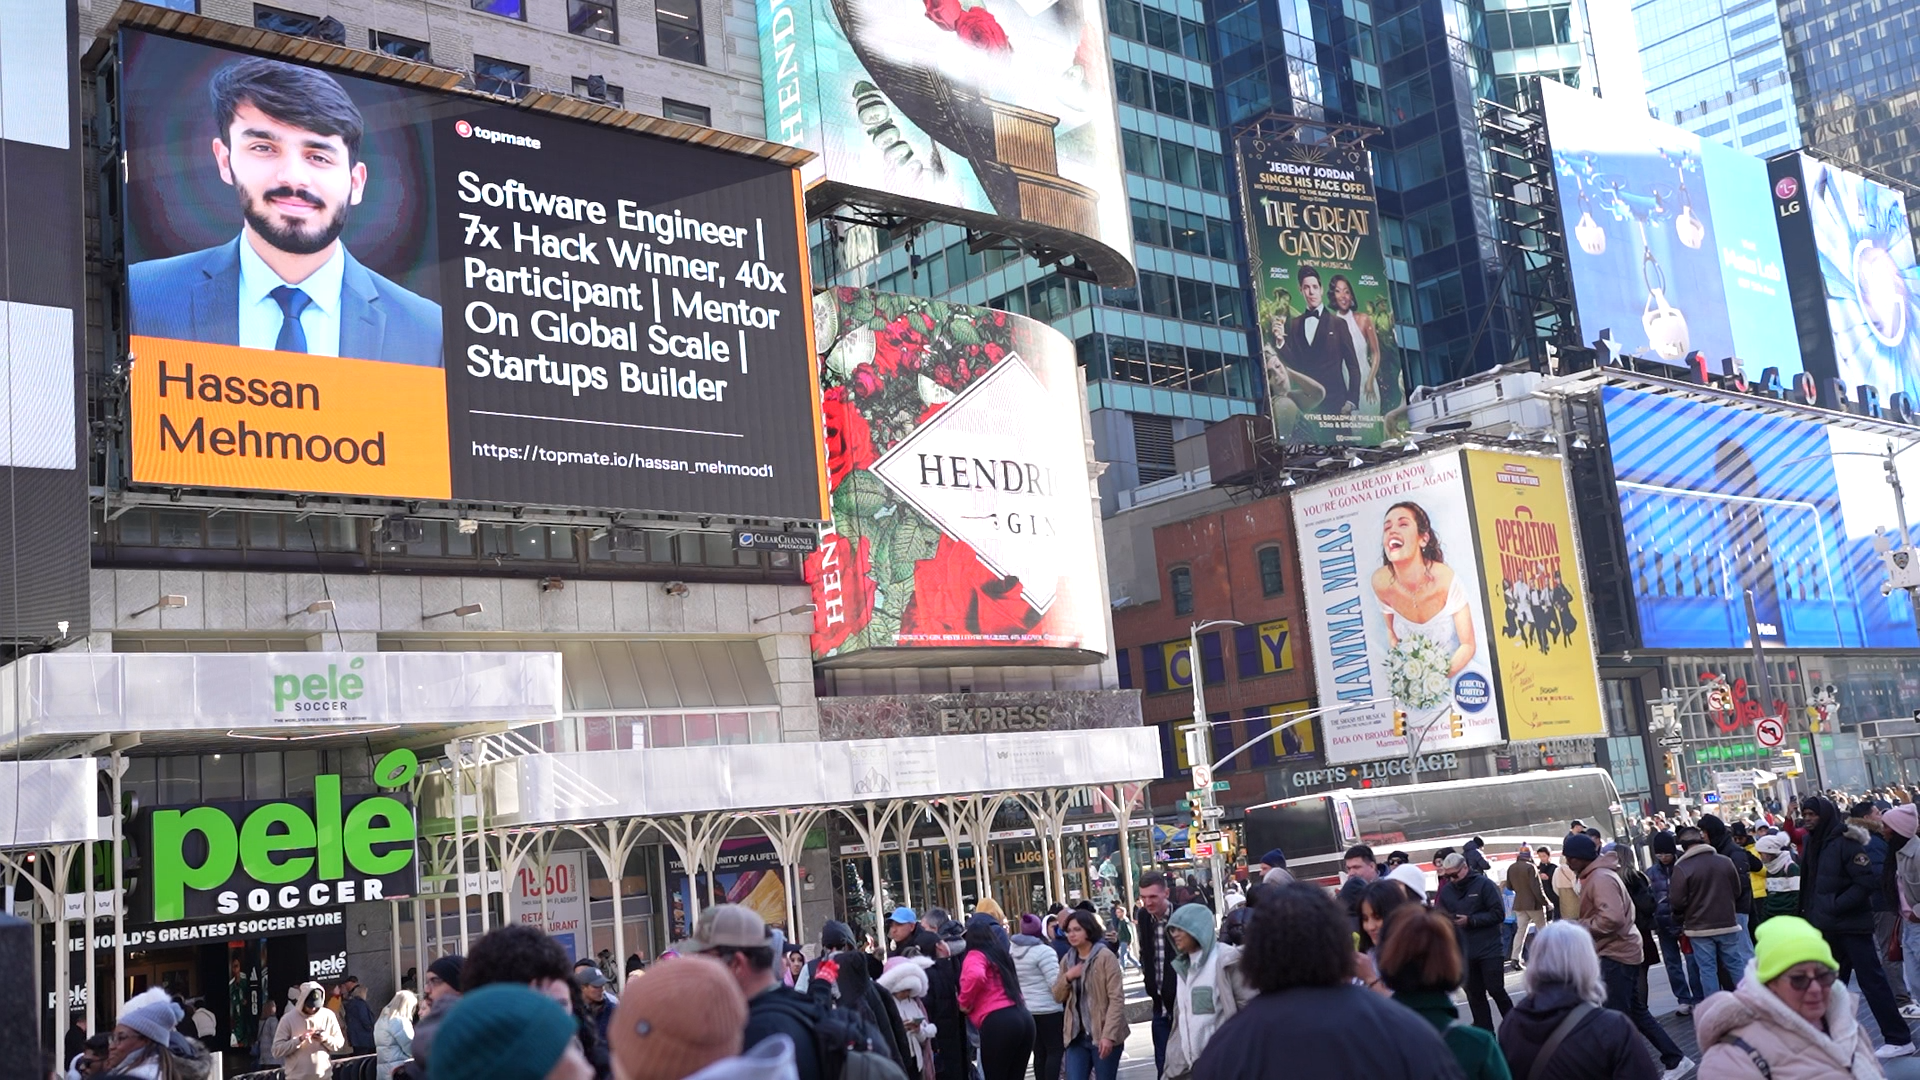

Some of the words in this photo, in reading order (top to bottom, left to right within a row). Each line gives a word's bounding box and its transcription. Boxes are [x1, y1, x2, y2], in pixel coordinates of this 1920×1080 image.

[771, 0, 804, 146] HEND
[474, 126, 542, 150] topmate
[1259, 173, 1292, 186] SINGS
[1294, 177, 1312, 188] HIS
[1315, 180, 1340, 191] FACE
[1342, 182, 1366, 194] OFF!
[1313, 168, 1355, 181] JORDAN
[458, 171, 606, 224] Software
[617, 199, 747, 249] Engineer
[1264, 200, 1300, 229] THE
[1303, 204, 1369, 236] GREAT
[1780, 201, 1800, 217] LG
[458, 213, 502, 250] 7x
[513, 221, 600, 265] Hack
[606, 237, 727, 289] Winner,
[735, 261, 787, 295] 40x
[1279, 230, 1361, 261] GATSBY
[1303, 260, 1320, 268] NEW
[1321, 261, 1352, 270] MUSICAL
[464, 256, 643, 312] Participant
[672, 288, 780, 330] Mentor
[464, 301, 519, 338] On
[531, 309, 638, 353] Global
[648, 324, 730, 364] Scale
[159, 360, 320, 411] Hassan
[467, 344, 608, 397] Startups
[620, 361, 728, 403] Builder
[1323, 414, 1356, 422] BROADWAY
[160, 413, 386, 466] Mehmood
[472, 441, 775, 478] https://topmate.io/hassan_mehmood1
[1303, 500, 1337, 517] YOU'RE
[1338, 494, 1373, 510] GONNA
[1375, 486, 1399, 501] LOVE
[1422, 469, 1458, 486] AGAIN!
[1327, 483, 1348, 498] YOU
[1350, 474, 1393, 494] ALREADY
[1396, 465, 1426, 482] KNOW
[1495, 518, 1559, 558] OPERATION
[1314, 522, 1362, 595] MIA!
[1263, 623, 1284, 632] MUSICAL
[1261, 631, 1288, 669] Y
[1326, 595, 1376, 714] MAMMA
[274, 656, 365, 712] pelé
[1456, 695, 1489, 705] ENGAGEMENT
[1459, 679, 1486, 688] STRICTLY
[1460, 688, 1485, 696] LIMITED
[294, 701, 348, 711] SOCCER
[940, 705, 1050, 733] EXPRESS
[1366, 712, 1387, 720] MUSICAL
[1332, 737, 1351, 745] BACK
[1352, 734, 1363, 742] ON
[1292, 767, 1347, 787] GIFTS
[1361, 753, 1459, 779] LUGGAGE
[152, 748, 419, 922] pelé
[738, 854, 748, 862] OF
[749, 853, 756, 861] A
[216, 878, 385, 915] SOCCER
[554, 896, 578, 905] FLAGSHIP
[158, 922, 236, 943] GREATEST
[238, 916, 294, 934] SOCCER
[298, 911, 342, 928] STORE
[310, 951, 347, 976] pelé
